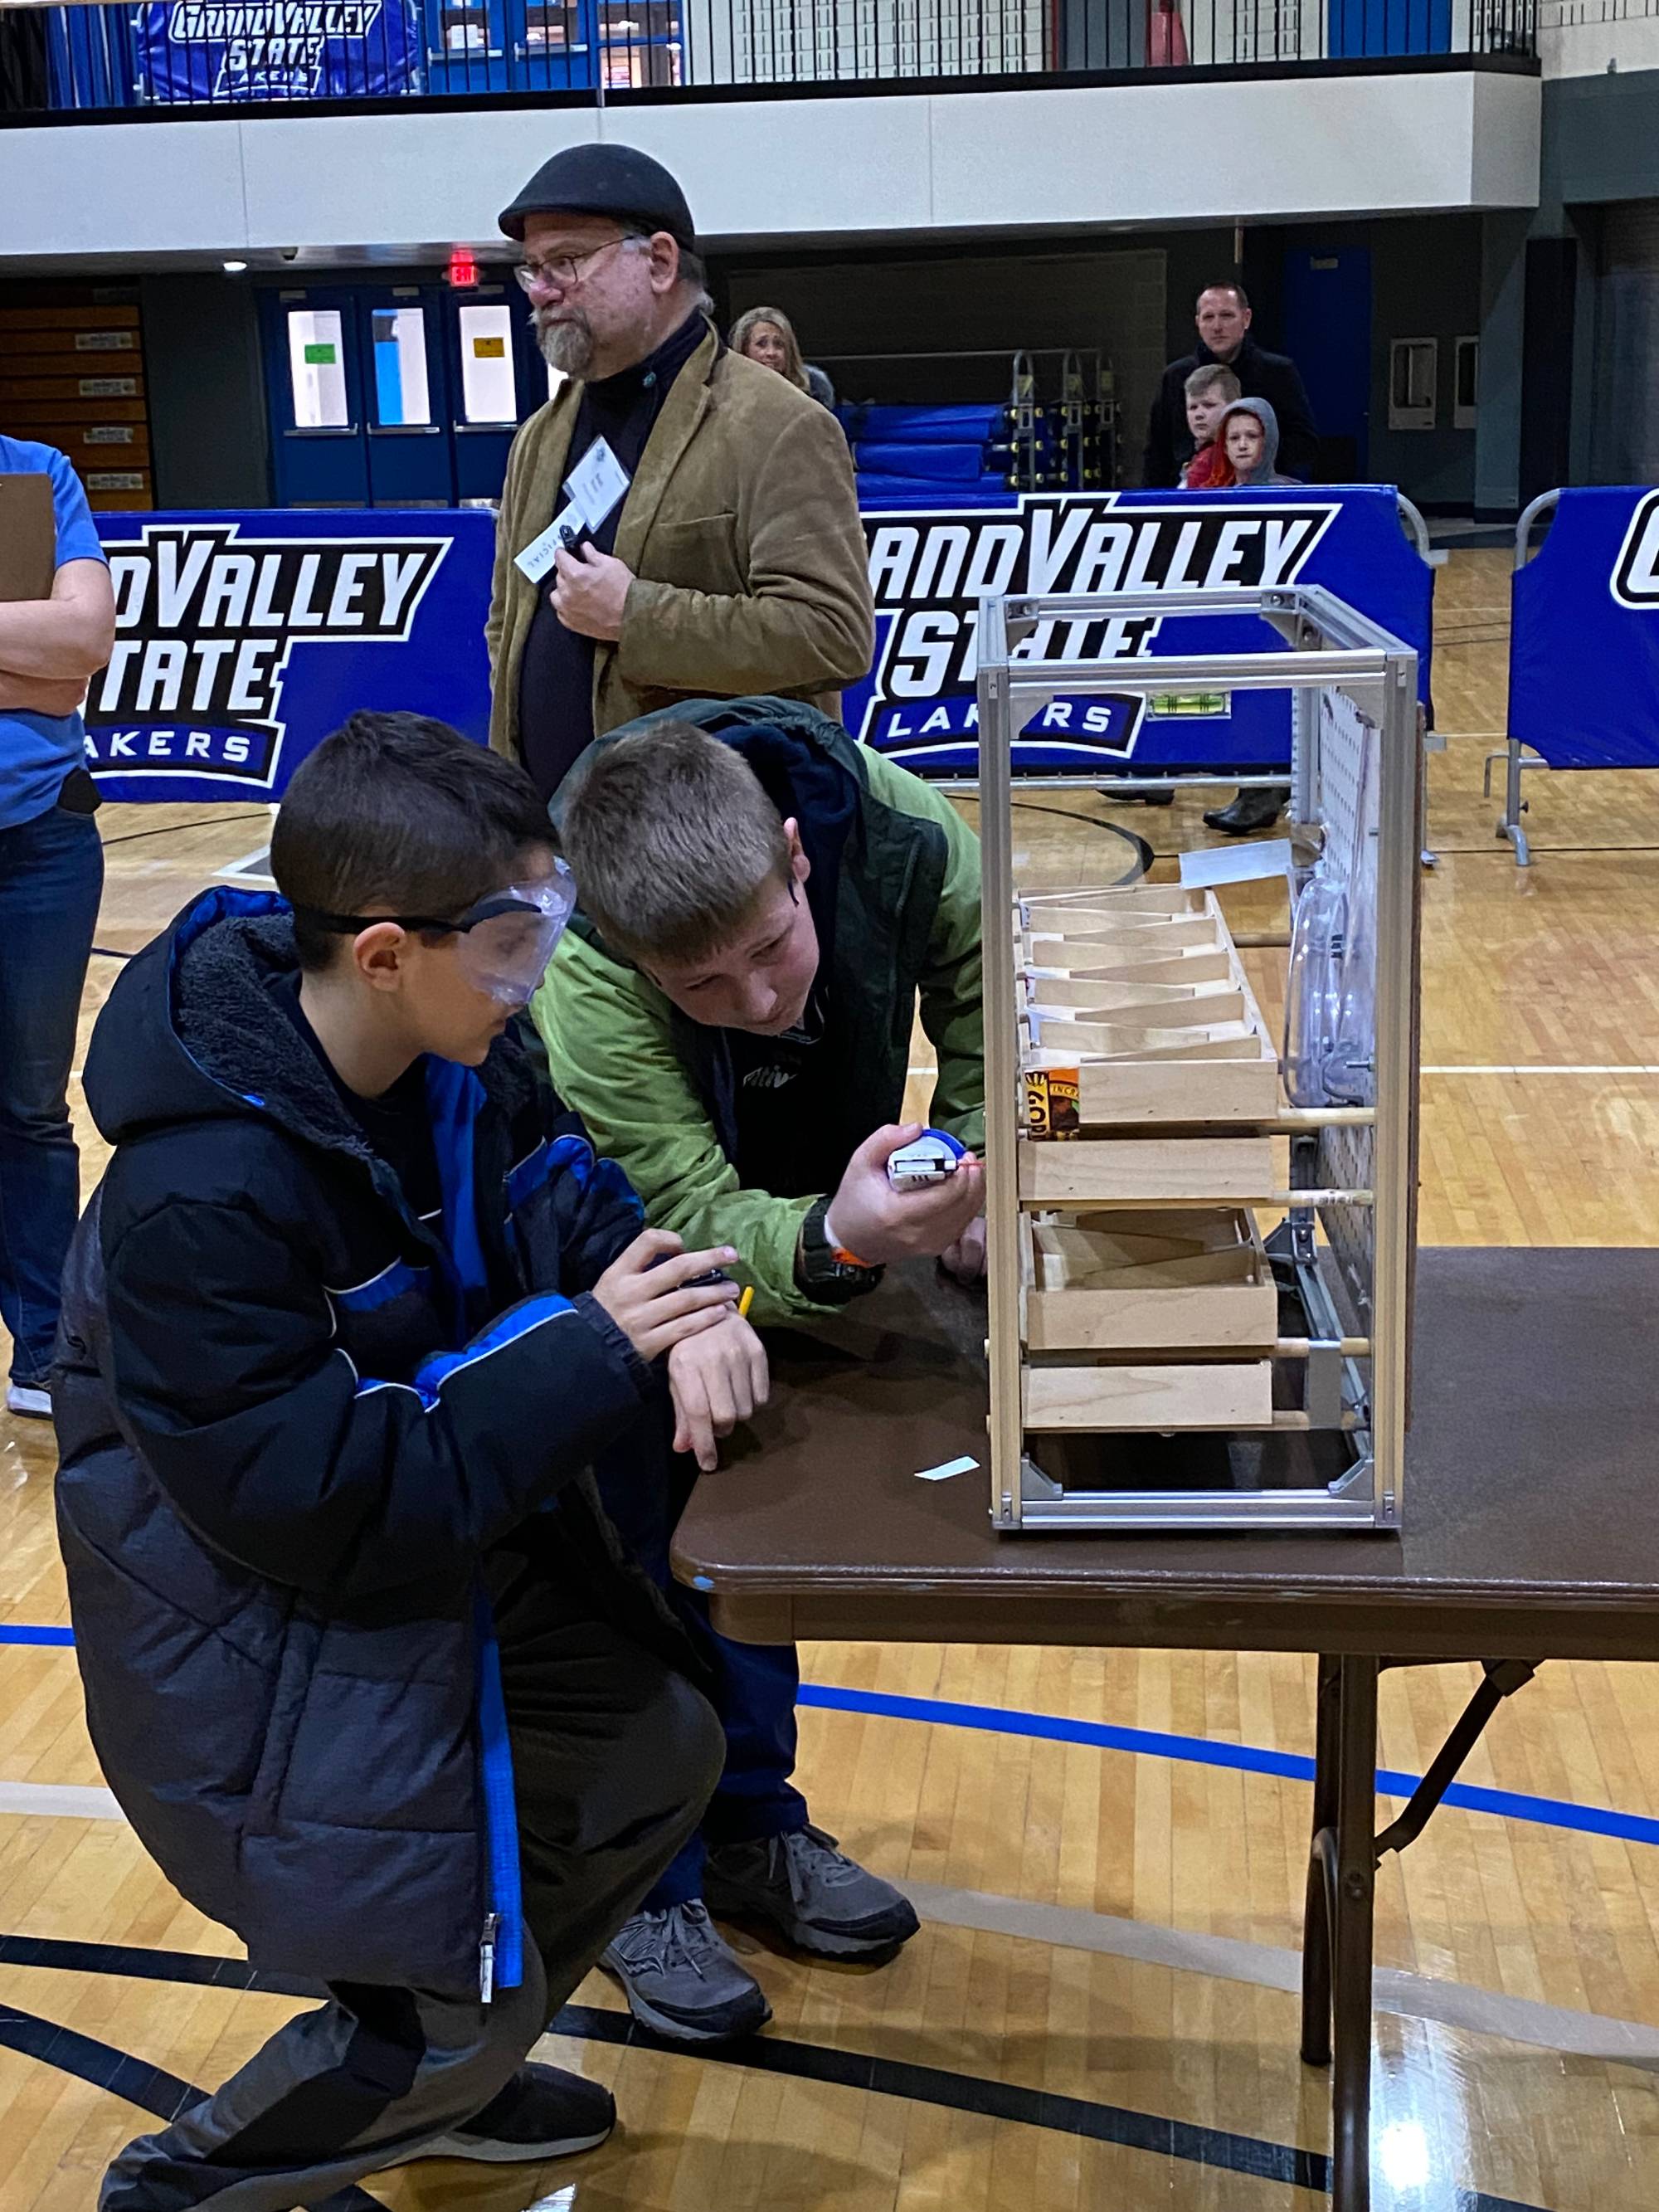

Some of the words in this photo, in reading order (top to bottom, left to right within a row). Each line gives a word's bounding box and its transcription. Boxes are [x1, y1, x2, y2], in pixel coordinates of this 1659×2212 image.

[229, 37, 319, 71] STATE
[227, 70, 308, 85] AKERS
[99, 640, 276, 712] TATE
[887, 702, 1112, 738] LAKRS
[84, 730, 250, 763] AKERS
